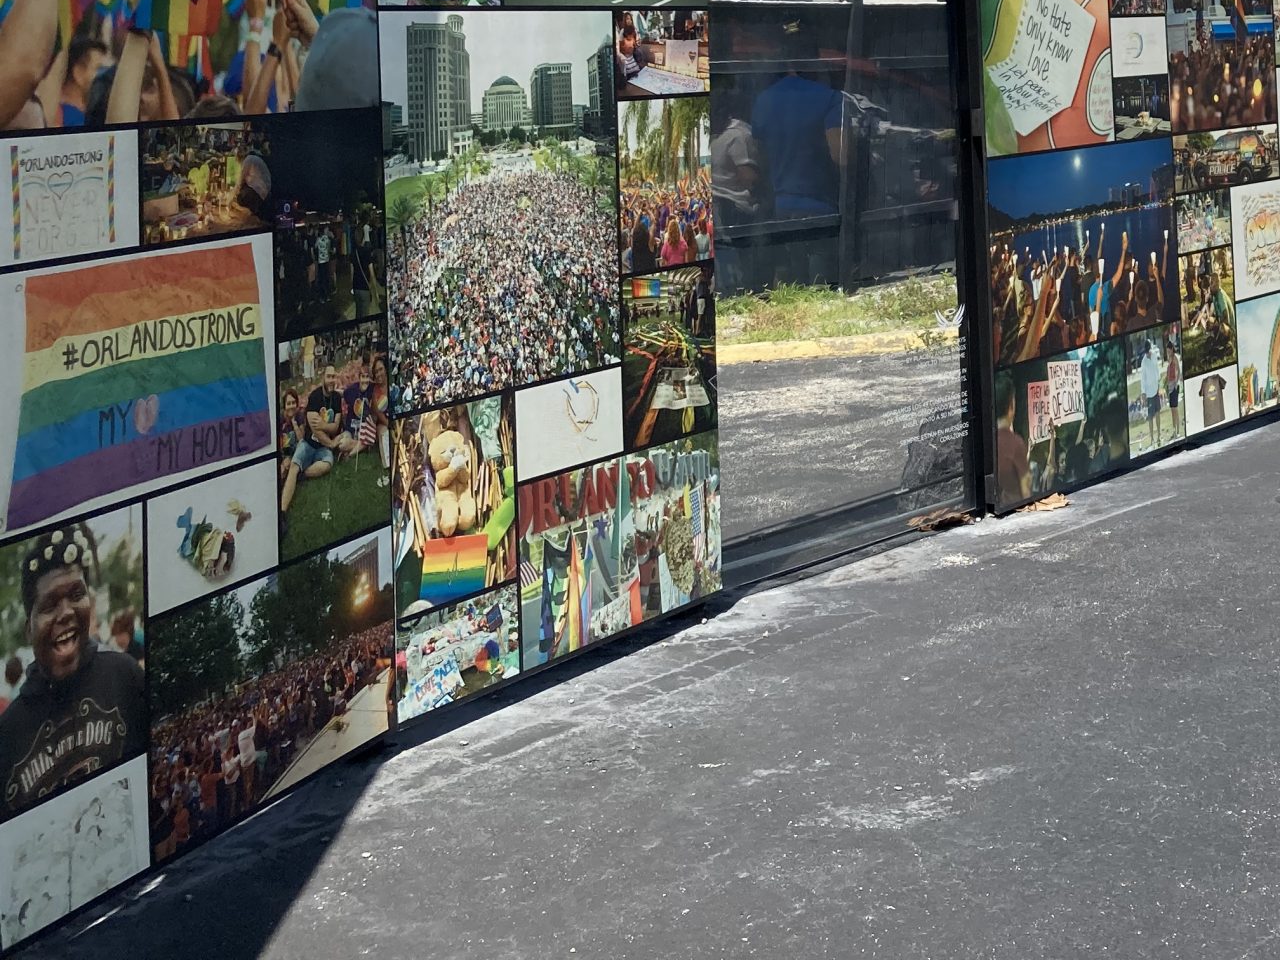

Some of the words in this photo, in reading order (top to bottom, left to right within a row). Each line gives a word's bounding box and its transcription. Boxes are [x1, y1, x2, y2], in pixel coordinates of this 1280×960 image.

[1050, 3, 1071, 37] Hate
[1046, 32, 1073, 63] know
[998, 85, 1031, 111] always
[1008, 64, 1028, 79] Let
[1022, 79, 1050, 98] peace
[1049, 95, 1062, 108] be
[1008, 84, 1032, 99] your
[20, 150, 103, 172] #ORLANDOSTRONG
[1209, 163, 1237, 176] POLICE
[63, 307, 255, 370] #ORLANDOSTRONG
[1049, 364, 1062, 379] THEY
[1063, 363, 1078, 377] WERE
[1030, 386, 1043, 399] THEY
[1052, 392, 1061, 417] OF
[1062, 390, 1084, 413] COLOR
[1032, 401, 1050, 415] PEOPLE
[99, 399, 133, 448] MY
[939, 429, 968, 443] CORAZONES
[1033, 424, 1051, 440] COLO
[155, 430, 185, 471] MY
[192, 417, 249, 464] HOME
[21, 745, 55, 793] HAIR
[66, 730, 84, 751] TE
[85, 720, 114, 747] DOG
